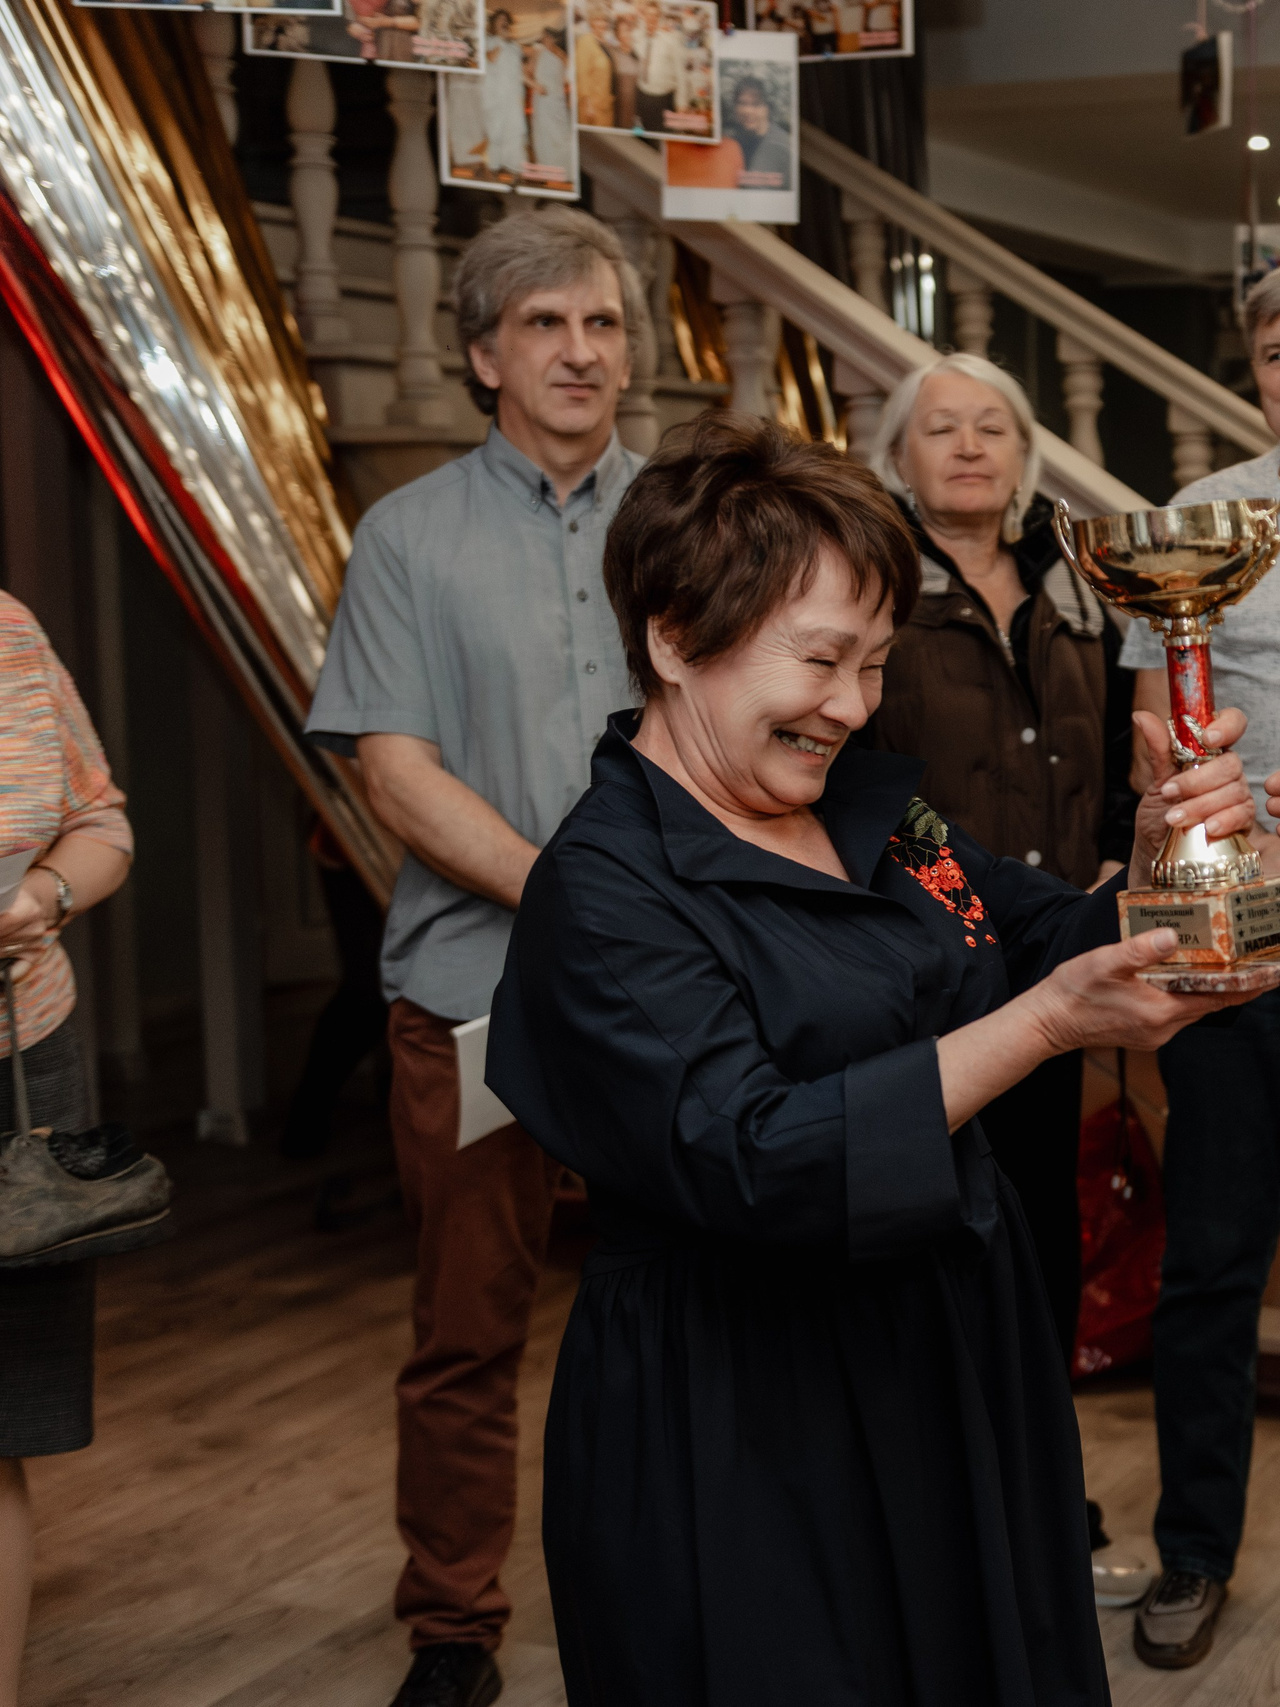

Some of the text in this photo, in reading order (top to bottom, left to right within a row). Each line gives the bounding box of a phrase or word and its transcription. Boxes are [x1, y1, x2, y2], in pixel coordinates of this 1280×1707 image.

[1140, 907, 1195, 918] Переходящий
[1248, 906, 1270, 919] Игорь
[1155, 919, 1181, 928] Кубок
